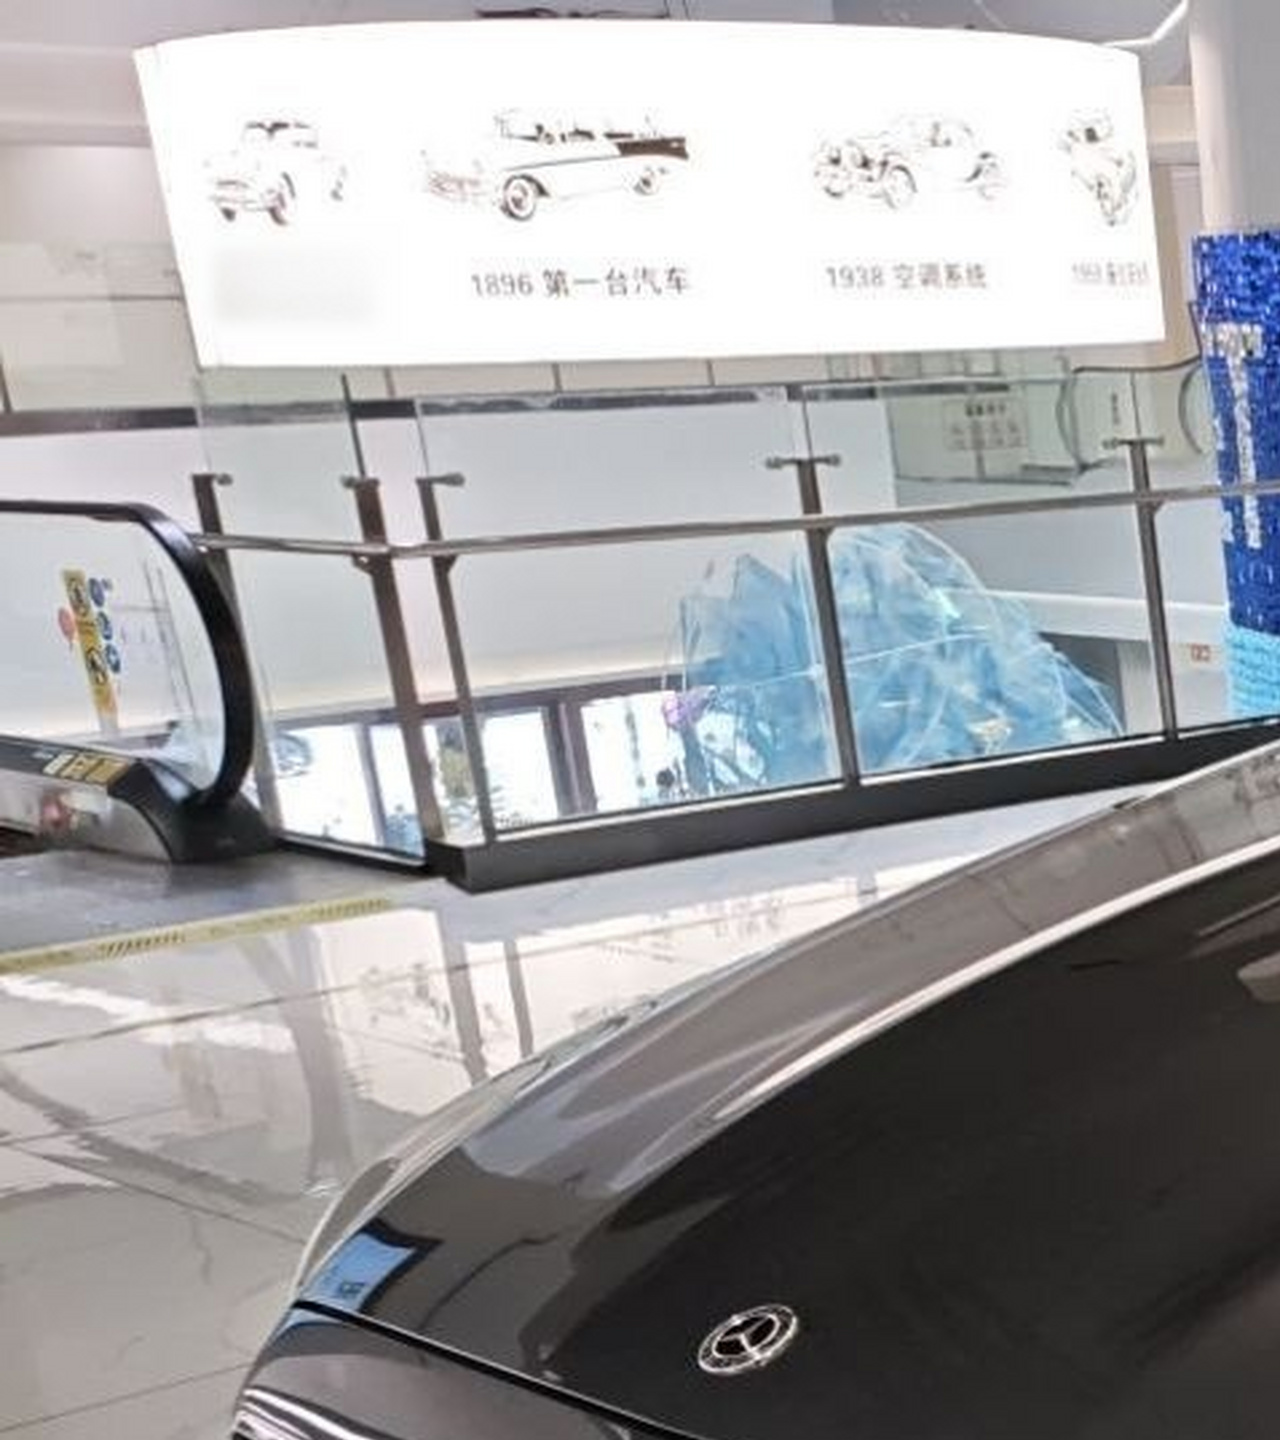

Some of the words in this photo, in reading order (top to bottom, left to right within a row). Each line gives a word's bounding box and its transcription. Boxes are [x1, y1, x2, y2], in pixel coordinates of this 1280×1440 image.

[470, 270, 535, 297] 1896
[541, 264, 690, 299] 第一台汽车
[825, 264, 885, 289] 1938
